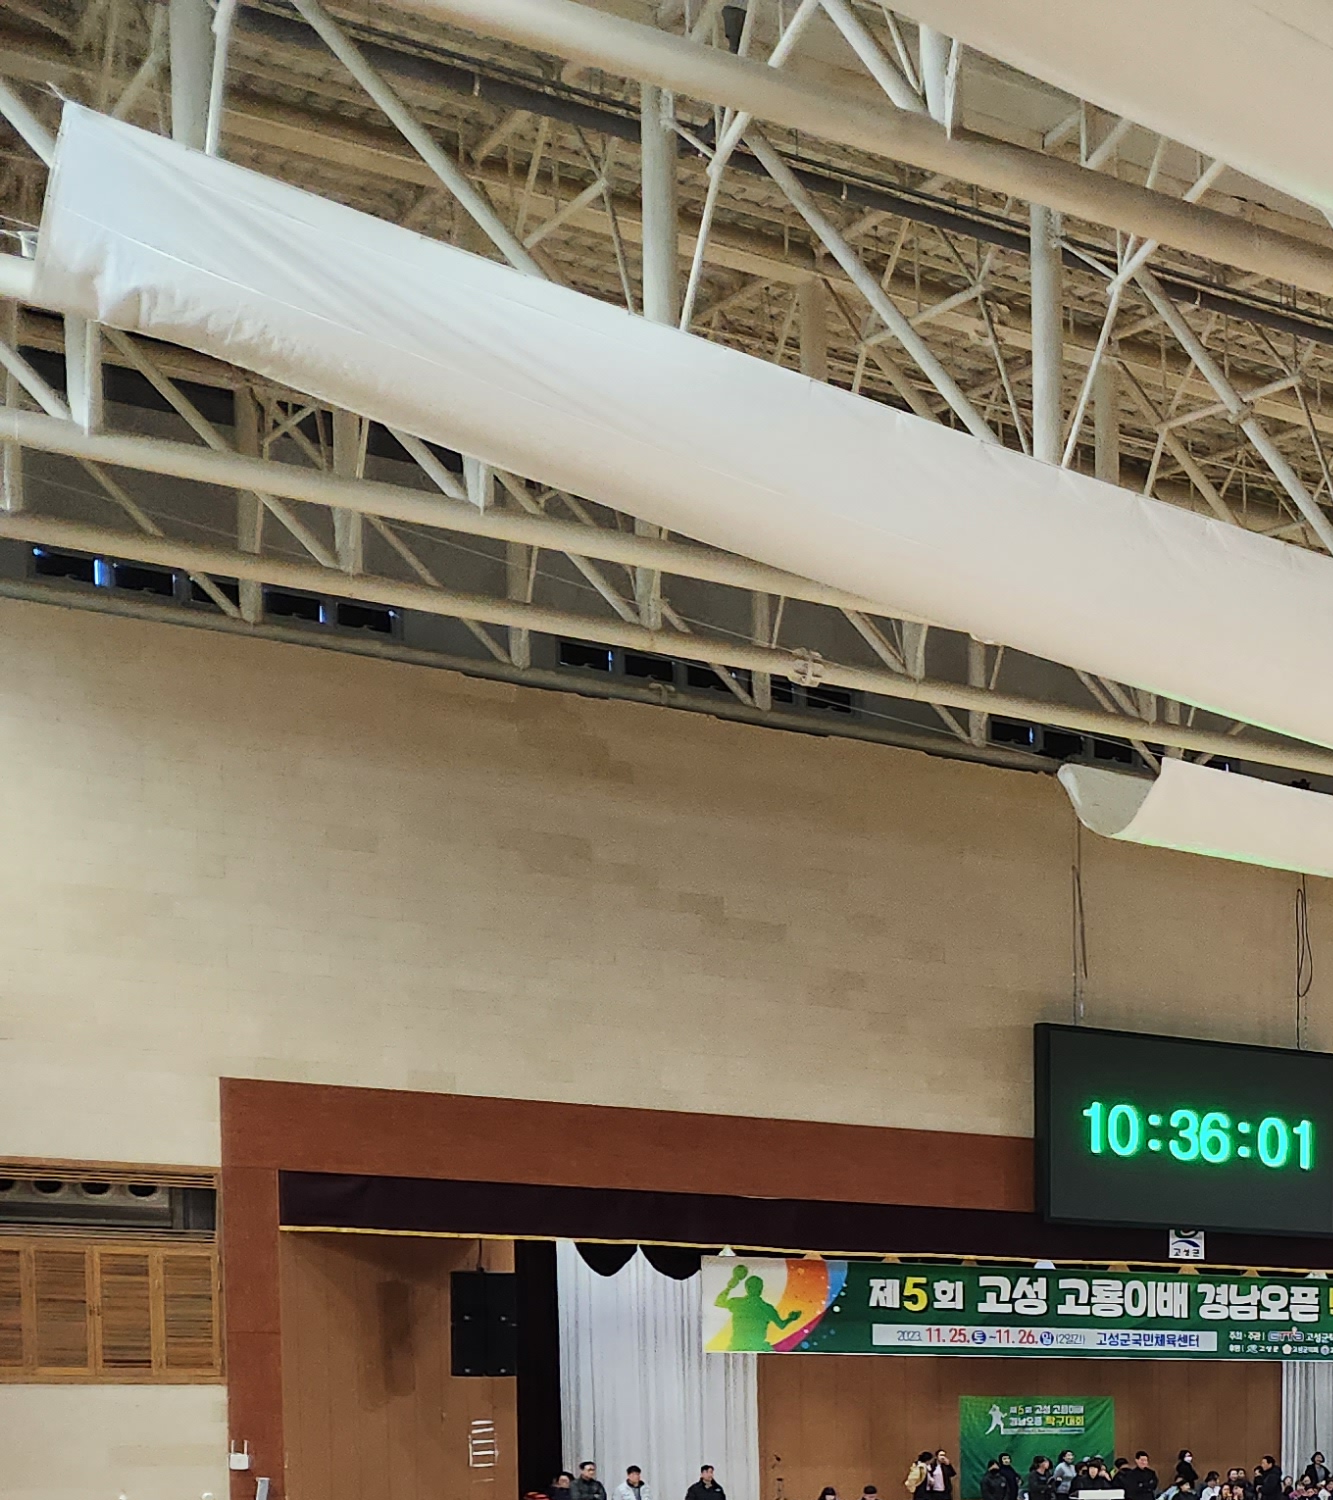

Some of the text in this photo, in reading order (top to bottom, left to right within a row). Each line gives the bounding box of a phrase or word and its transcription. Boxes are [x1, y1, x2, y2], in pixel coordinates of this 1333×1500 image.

[1082, 1101, 1313, 1170] 10:36:01
[868, 1276, 963, 1312] 제5회
[977, 1275, 1048, 1316] 고성
[1057, 1278, 1189, 1319] 고룡이배
[1197, 1283, 1320, 1323] 경남오픈
[1096, 1332, 1200, 1348] 고성군국민체육센터
[1044, 1415, 1084, 1427] 탁구대회
